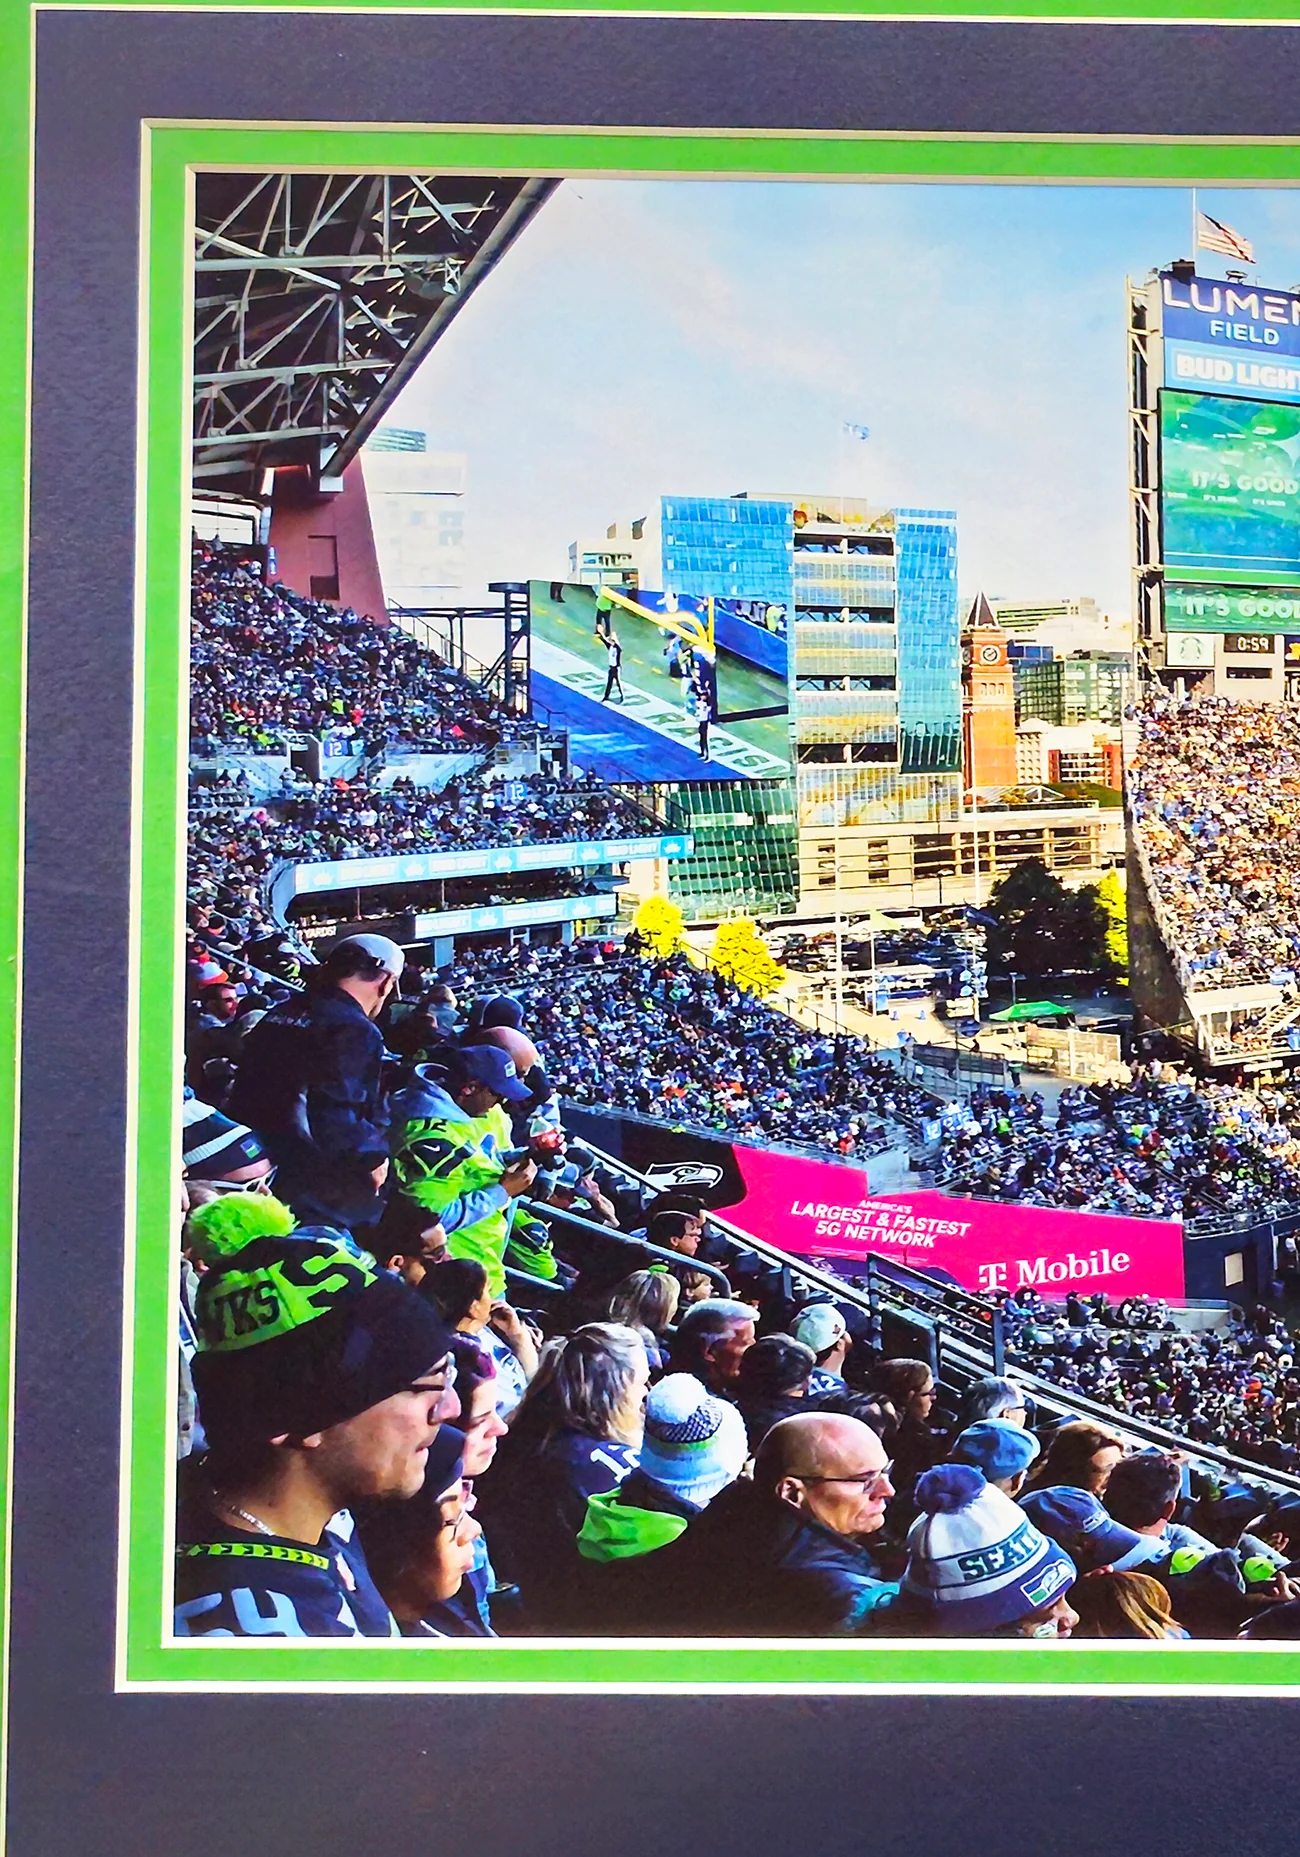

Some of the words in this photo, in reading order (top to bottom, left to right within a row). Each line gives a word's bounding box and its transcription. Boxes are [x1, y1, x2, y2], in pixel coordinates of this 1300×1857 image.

[1210, 319, 1280, 345] FIELD
[1176, 354, 1234, 383] BUD
[1191, 471, 1231, 489] IT'S
[1236, 475, 1300, 495] GOOD
[1185, 594, 1231, 616] IT'S
[1237, 636, 1269, 651] 0:59
[510, 783, 524, 800] 12
[790, 1200, 875, 1225] LARGEST
[876, 1212, 890, 1227] &
[893, 1214, 971, 1237] FASTEST
[815, 1220, 842, 1236] 5G
[844, 1224, 937, 1248] NETWORK
[1016, 1248, 1131, 1287] Mobile
